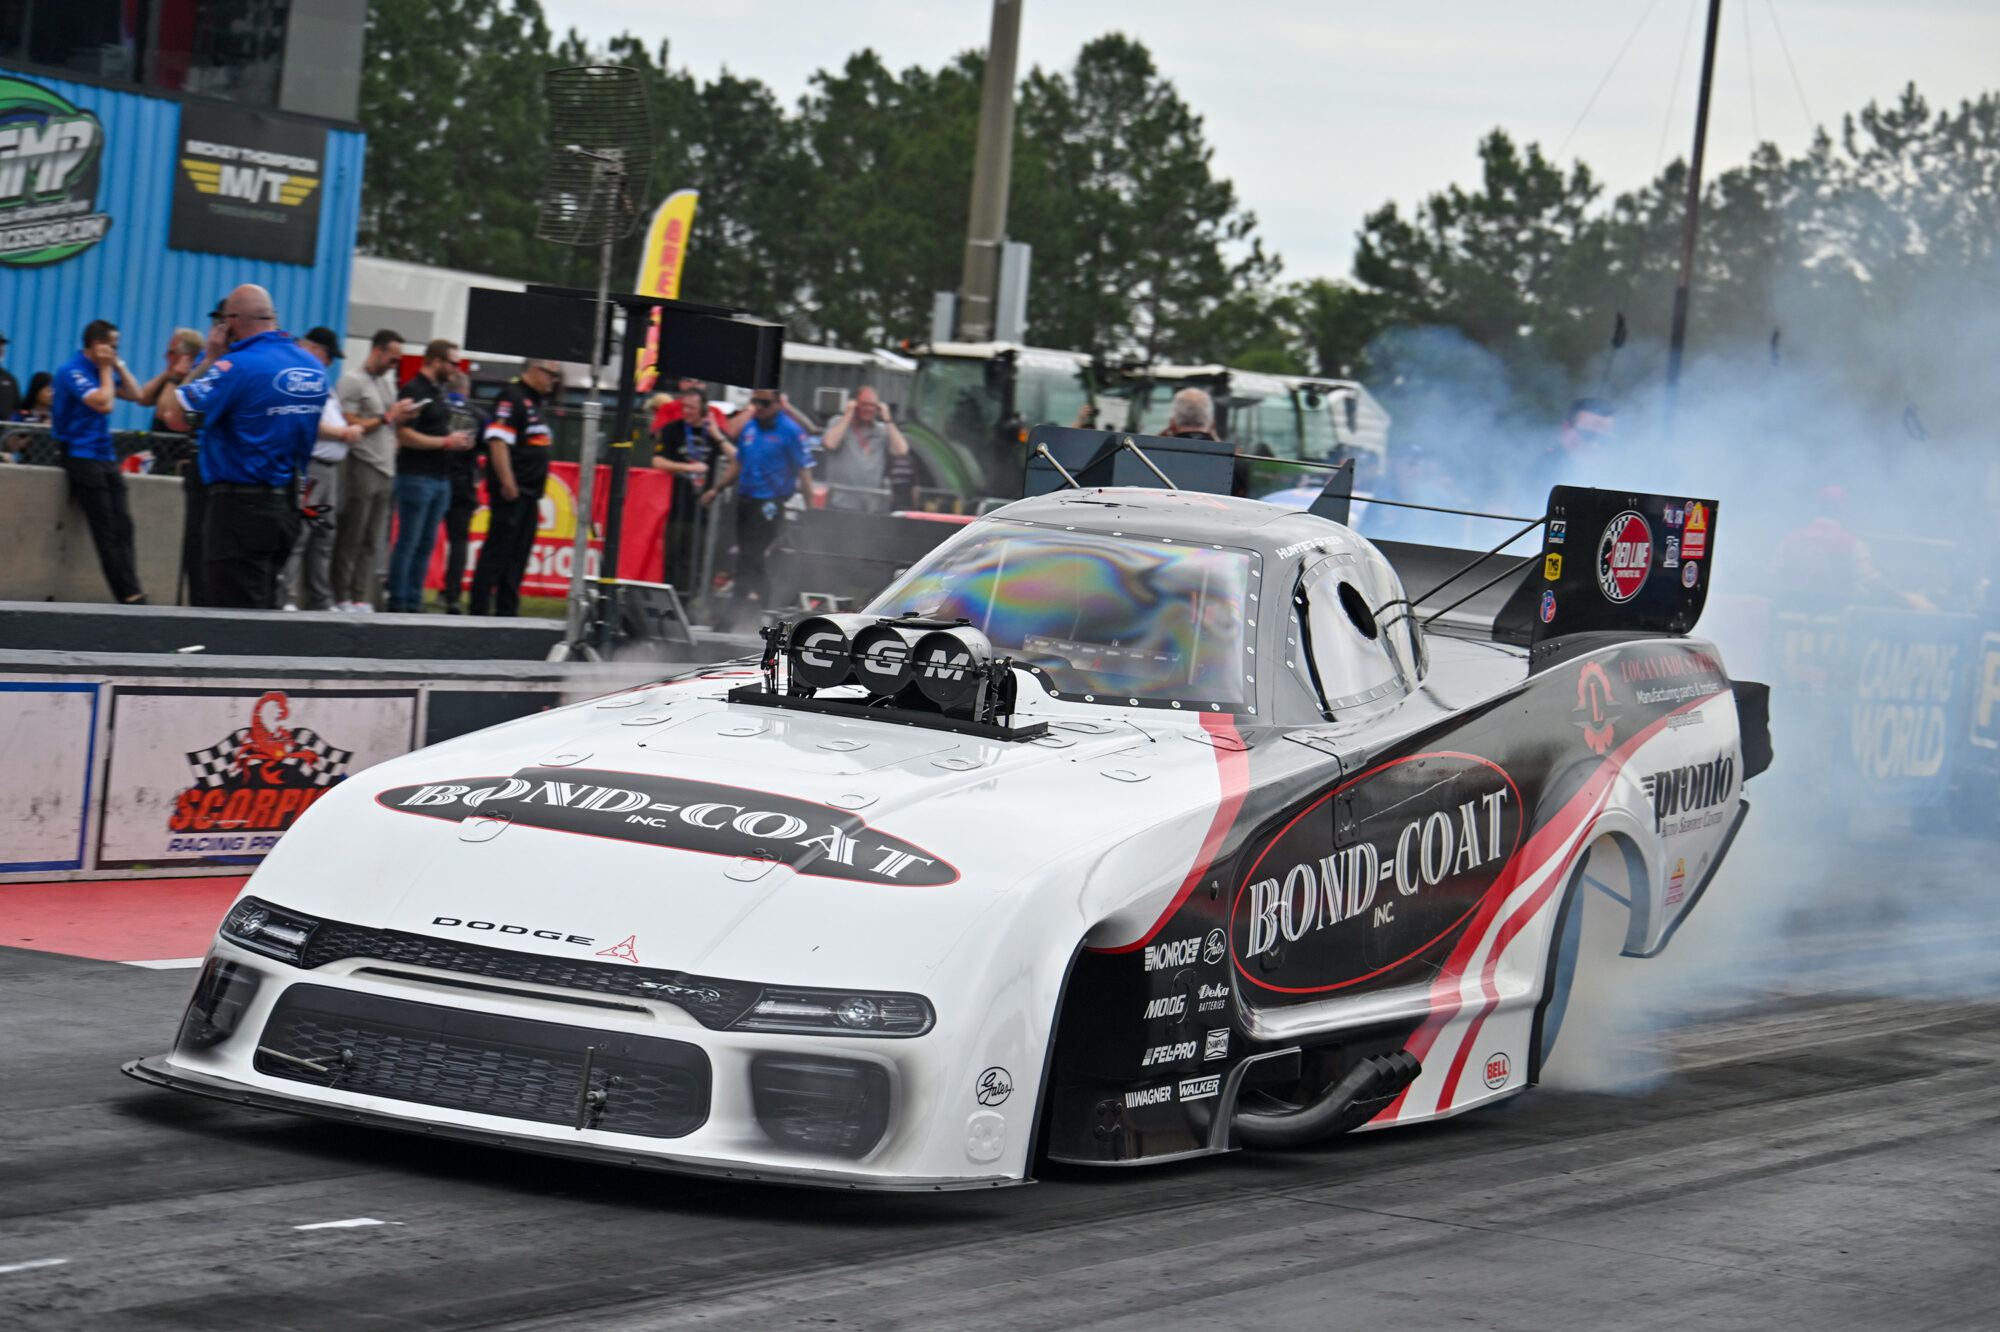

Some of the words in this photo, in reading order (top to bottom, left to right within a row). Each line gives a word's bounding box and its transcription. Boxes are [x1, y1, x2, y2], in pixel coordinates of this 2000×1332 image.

[219, 163, 289, 204] M/T
[287, 370, 325, 392] Ford
[266, 404, 322, 416] RACIN
[1613, 543, 1630, 568] RED
[1630, 542, 1649, 567] LINE
[1621, 657, 1661, 683] LOGAN
[1851, 703, 1946, 778] WORLD
[1655, 749, 1734, 833] pronto
[168, 787, 332, 830] SCORPI
[624, 814, 667, 828] INC.
[397, 777, 935, 879] BOND-COAT
[168, 836, 246, 852] RACING
[1245, 785, 1508, 959] BOND-COAT
[1373, 901, 1395, 928] INC.
[432, 916, 596, 946] DODGE
[1145, 937, 1201, 971] MONROE
[639, 981, 703, 996] SRT
[1198, 983, 1230, 999] Deka
[1144, 994, 1187, 1019] MOOG
[1198, 999, 1225, 1012] BATTERIES
[1150, 1040, 1197, 1065] FEL-PRO
[1207, 1037, 1228, 1051] CHAMPION
[1487, 1059, 1507, 1080] BELL
[978, 1071, 1012, 1105] Gates
[1133, 1086, 1172, 1107] WAGNER
[1180, 1079, 1219, 1097] WALKER
